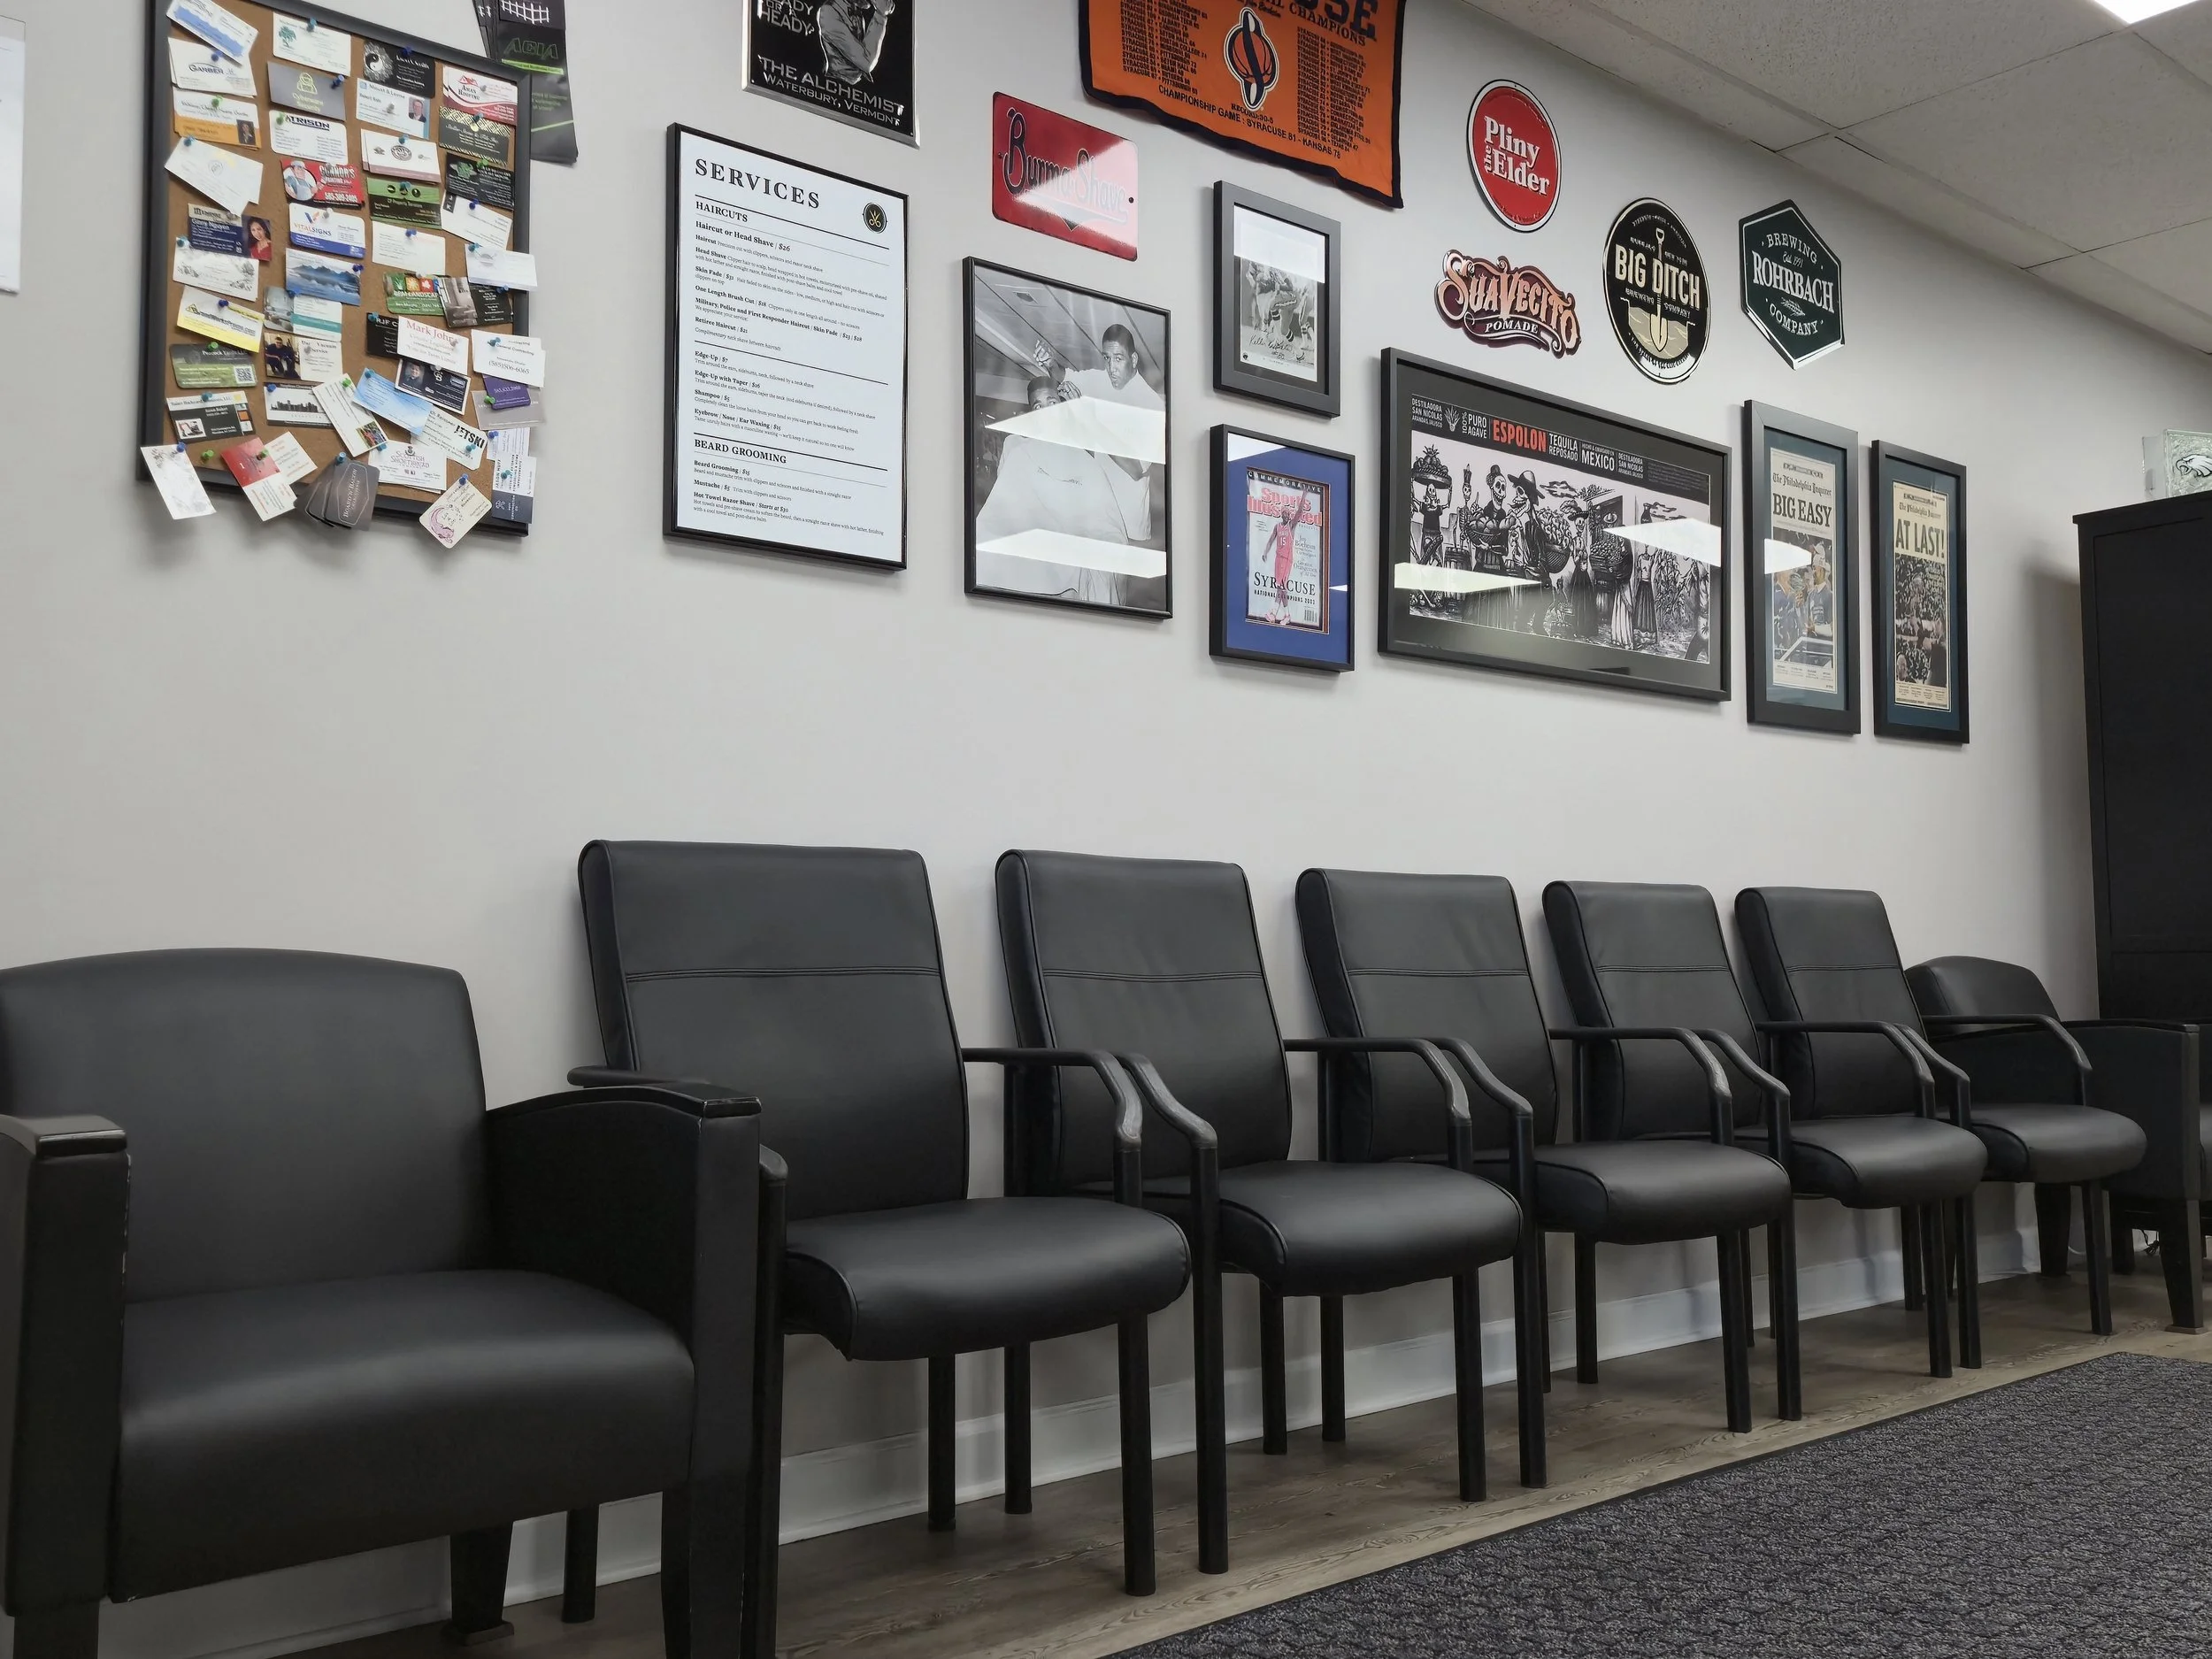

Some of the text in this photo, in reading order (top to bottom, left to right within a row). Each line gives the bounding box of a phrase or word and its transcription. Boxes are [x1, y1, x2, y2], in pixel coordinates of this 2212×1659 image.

[1289, 3, 1366, 47] CHAMPIONS
[758, 55, 904, 116] THE ALCHEMIST
[764, 72, 901, 126] WATERBURY, VERMONT
[1159, 84, 1217, 114] CHAMPIONSHIP
[1218, 107, 1240, 123] GAME
[1247, 119, 1287, 139] SYRACUSE
[1302, 138, 1333, 155] KANSAS
[1484, 115, 1540, 168] Pliny
[1483, 145, 1550, 196] the Elder
[695, 157, 820, 210] SERVICES
[695, 200, 748, 223] HAIRCUTS
[695, 219, 723, 234] Haircut
[733, 230, 752, 242] Head
[754, 235, 773, 248] Shave
[779, 242, 790, 253] $26
[695, 234, 716, 244] Haircut
[695, 246, 710, 255] Head
[710, 250, 726, 259] Shave
[1766, 233, 1817, 265] BREWING
[695, 265, 708, 274] Skin
[709, 269, 722, 278] Fade
[1615, 243, 1700, 310] BIG DITCH
[1752, 250, 1835, 314] ROHRBACH
[707, 288, 726, 299] Length
[727, 293, 743, 302] Brush
[695, 297, 719, 309] Military,
[719, 303, 736, 311] Police
[762, 313, 789, 326] Responder
[790, 320, 810, 330] Haircut
[695, 316, 715, 326] Retiree
[716, 321, 736, 331] Haircut
[1770, 303, 1819, 335] COMPANY
[406, 320, 431, 335] Mark
[1485, 319, 1539, 334] POMADE
[695, 350, 718, 362] Edge-Up
[695, 370, 718, 380] Edge-Up
[732, 378, 749, 387] Taper
[695, 388, 720, 400] Shampoo
[1412, 398, 1442, 412] DESTILADORA
[1412, 407, 1442, 421] SAN NICOLAS
[695, 408, 718, 419] Eyebrow
[750, 419, 770, 429] Waxing
[1468, 413, 1487, 428] PURO
[1467, 424, 1487, 439] AGAVE
[1493, 418, 1547, 453] ESPOLON
[695, 439, 787, 464] BEARD GROOMING
[1549, 433, 1578, 452] TEQUILA
[1548, 446, 1578, 462] REPOSADO
[1618, 452, 1643, 465] DESTILADORA
[711, 463, 739, 474] Grooming
[1627, 463, 1643, 472] NICOLAS
[694, 479, 720, 489] Mustache
[1248, 471, 1321, 492] COMMEMORATIVE
[1772, 472, 1832, 496] The Philadelphia Inquirer
[704, 493, 721, 502] Towel
[1772, 493, 1832, 527] BIG EASY
[1895, 518, 1945, 559] AT LAST!
[1254, 572, 1316, 595] SYRACUSE
[1254, 589, 1276, 598] NATIONAL
